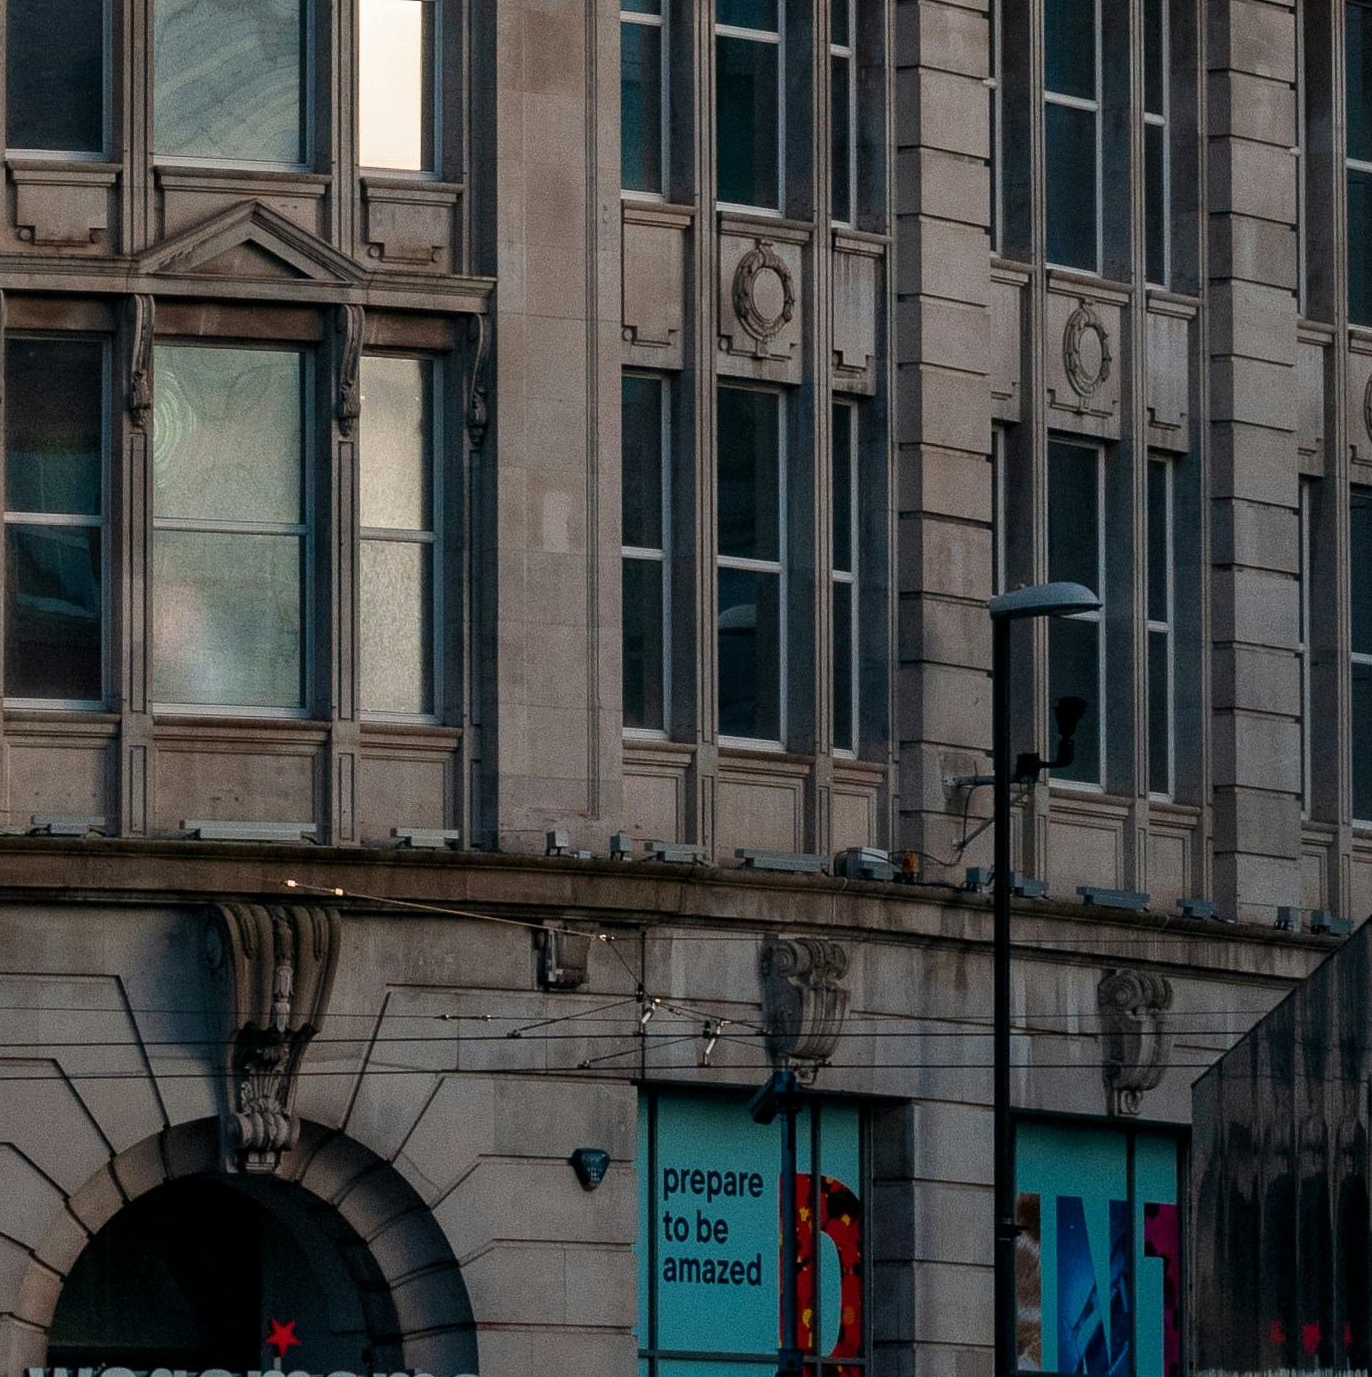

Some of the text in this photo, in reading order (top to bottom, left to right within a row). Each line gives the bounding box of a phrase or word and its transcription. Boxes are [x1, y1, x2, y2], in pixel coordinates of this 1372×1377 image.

[662, 1166, 764, 1204] prepare
[662, 1209, 729, 1245] to be
[662, 1252, 762, 1287] amazed
